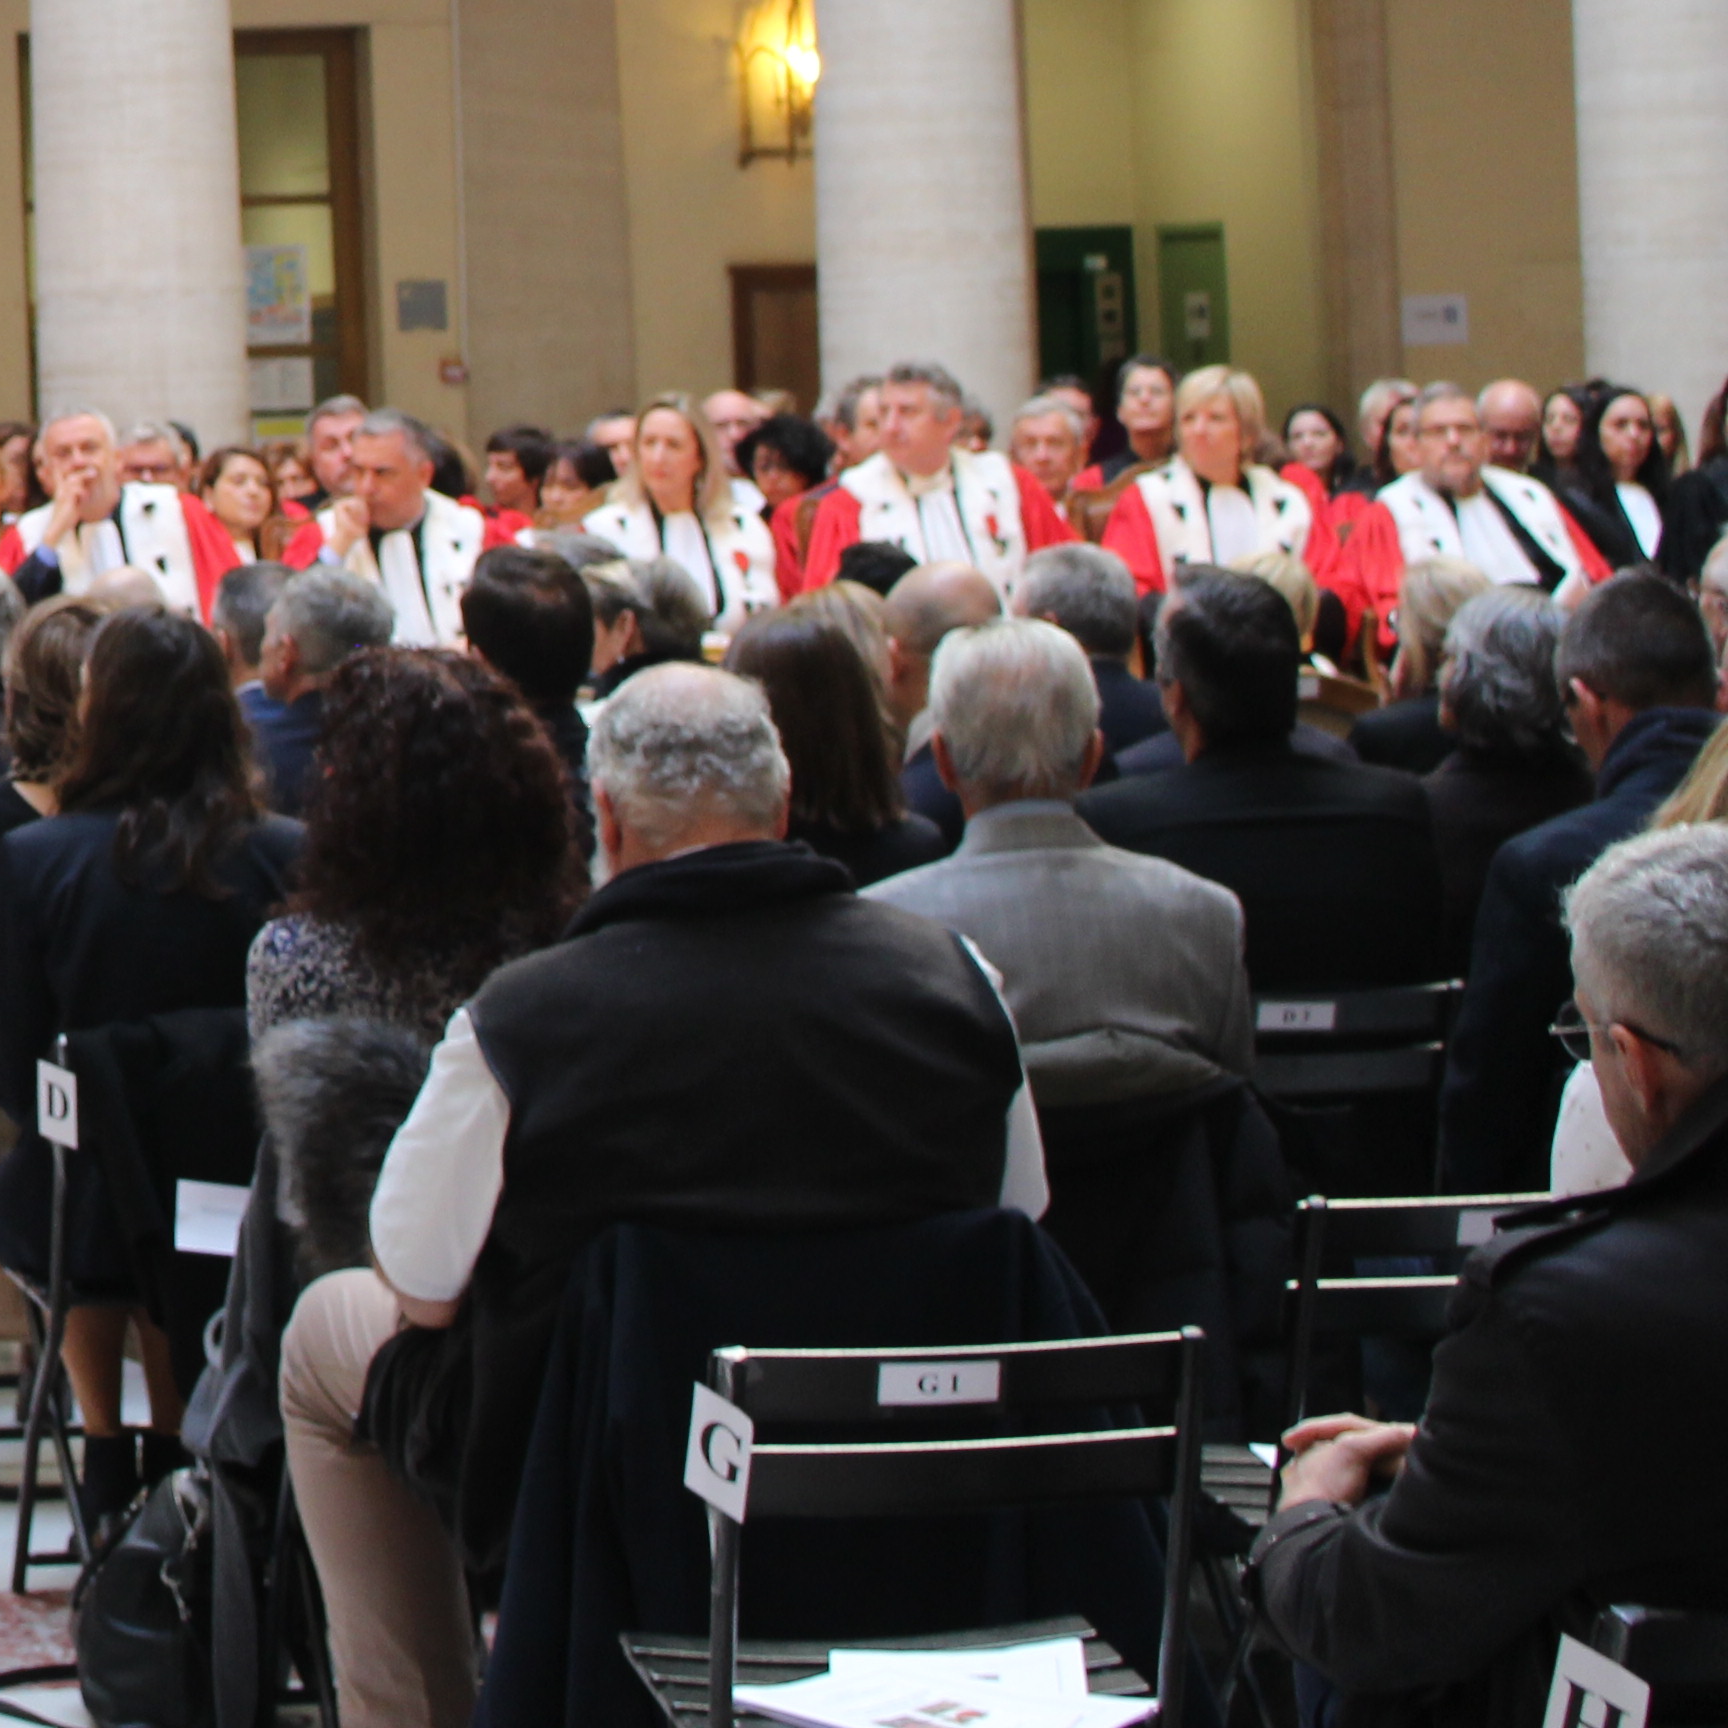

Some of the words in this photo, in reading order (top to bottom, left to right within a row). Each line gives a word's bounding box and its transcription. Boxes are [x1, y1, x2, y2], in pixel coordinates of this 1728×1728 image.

[45, 1080, 69, 1121] D
[918, 1373, 939, 1394] G
[701, 1422, 742, 1484] G
